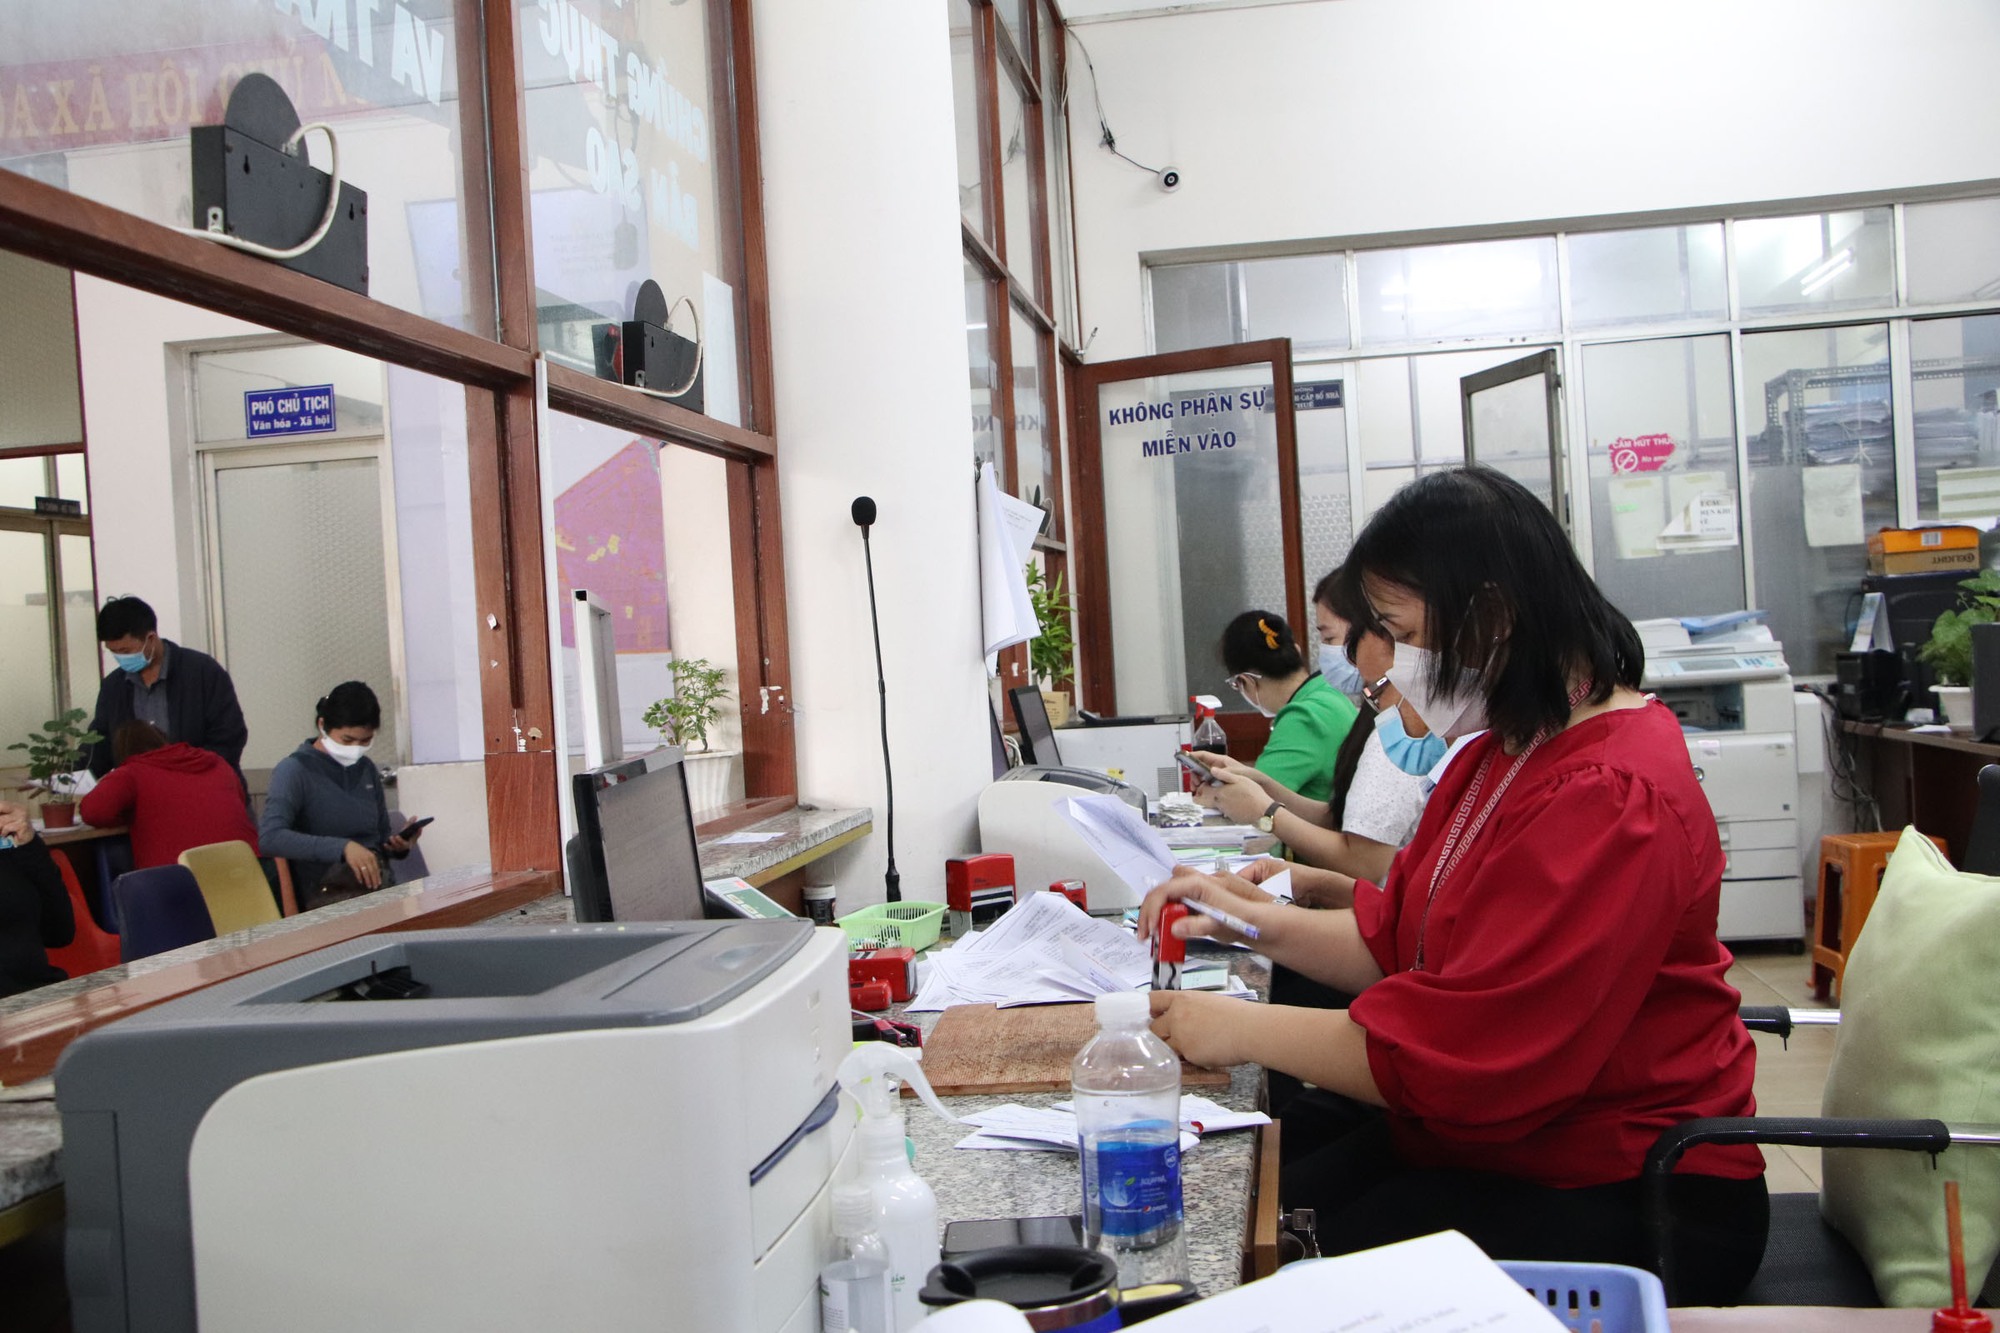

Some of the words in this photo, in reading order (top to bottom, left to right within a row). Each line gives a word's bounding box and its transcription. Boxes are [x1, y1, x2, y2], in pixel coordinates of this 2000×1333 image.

[251, 397, 274, 416] PHÓ
[277, 393, 300, 413] CHỦ
[303, 395, 329, 414] TỊCH
[1109, 402, 1174, 426] KHÔNG
[1180, 392, 1232, 418] PHẬN
[1239, 387, 1267, 413] SỰ
[274, 418, 291, 429] hóa
[1142, 430, 1191, 457] MIỄN
[1197, 428, 1237, 451] VÀO
